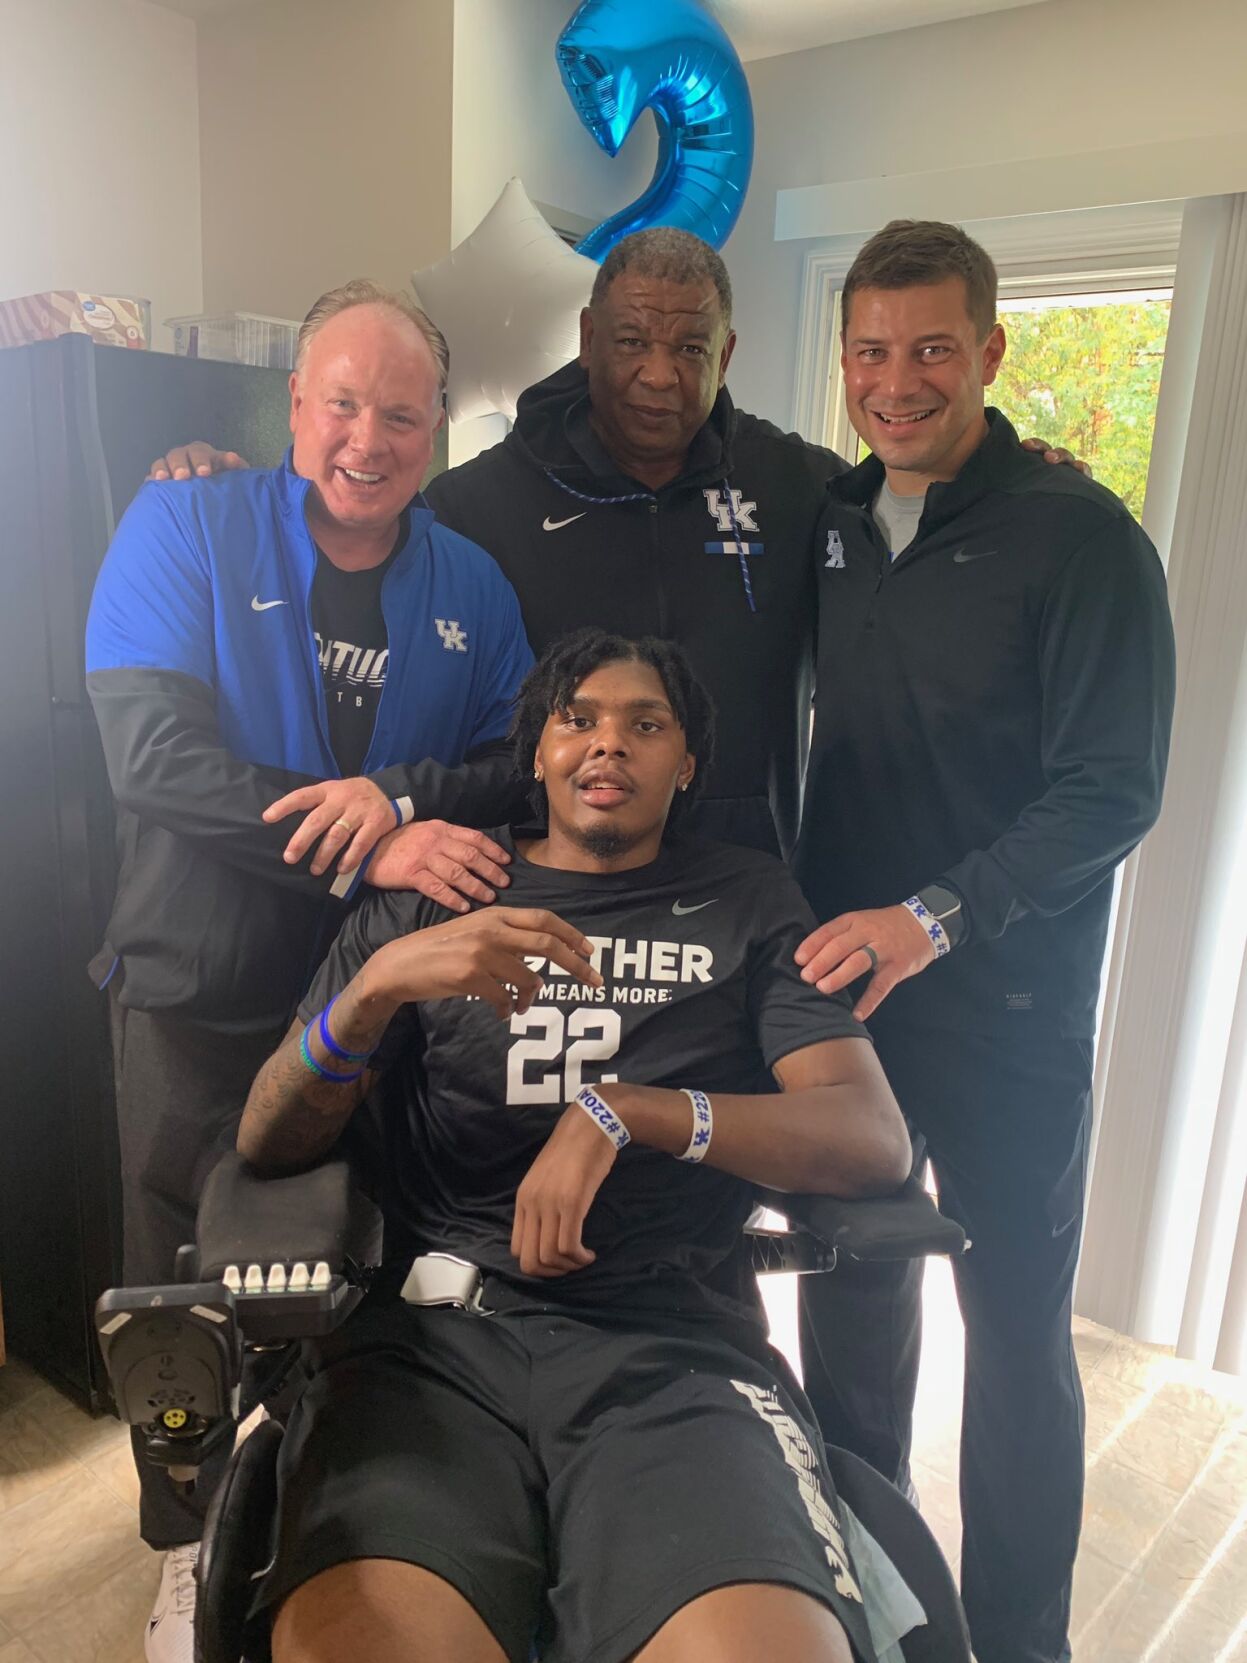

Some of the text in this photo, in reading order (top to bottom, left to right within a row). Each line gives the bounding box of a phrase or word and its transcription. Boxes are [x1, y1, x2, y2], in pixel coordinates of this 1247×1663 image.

[434, 618, 468, 652] UK
[538, 983, 606, 1002] MEANS
[505, 1006, 622, 1105] 22
